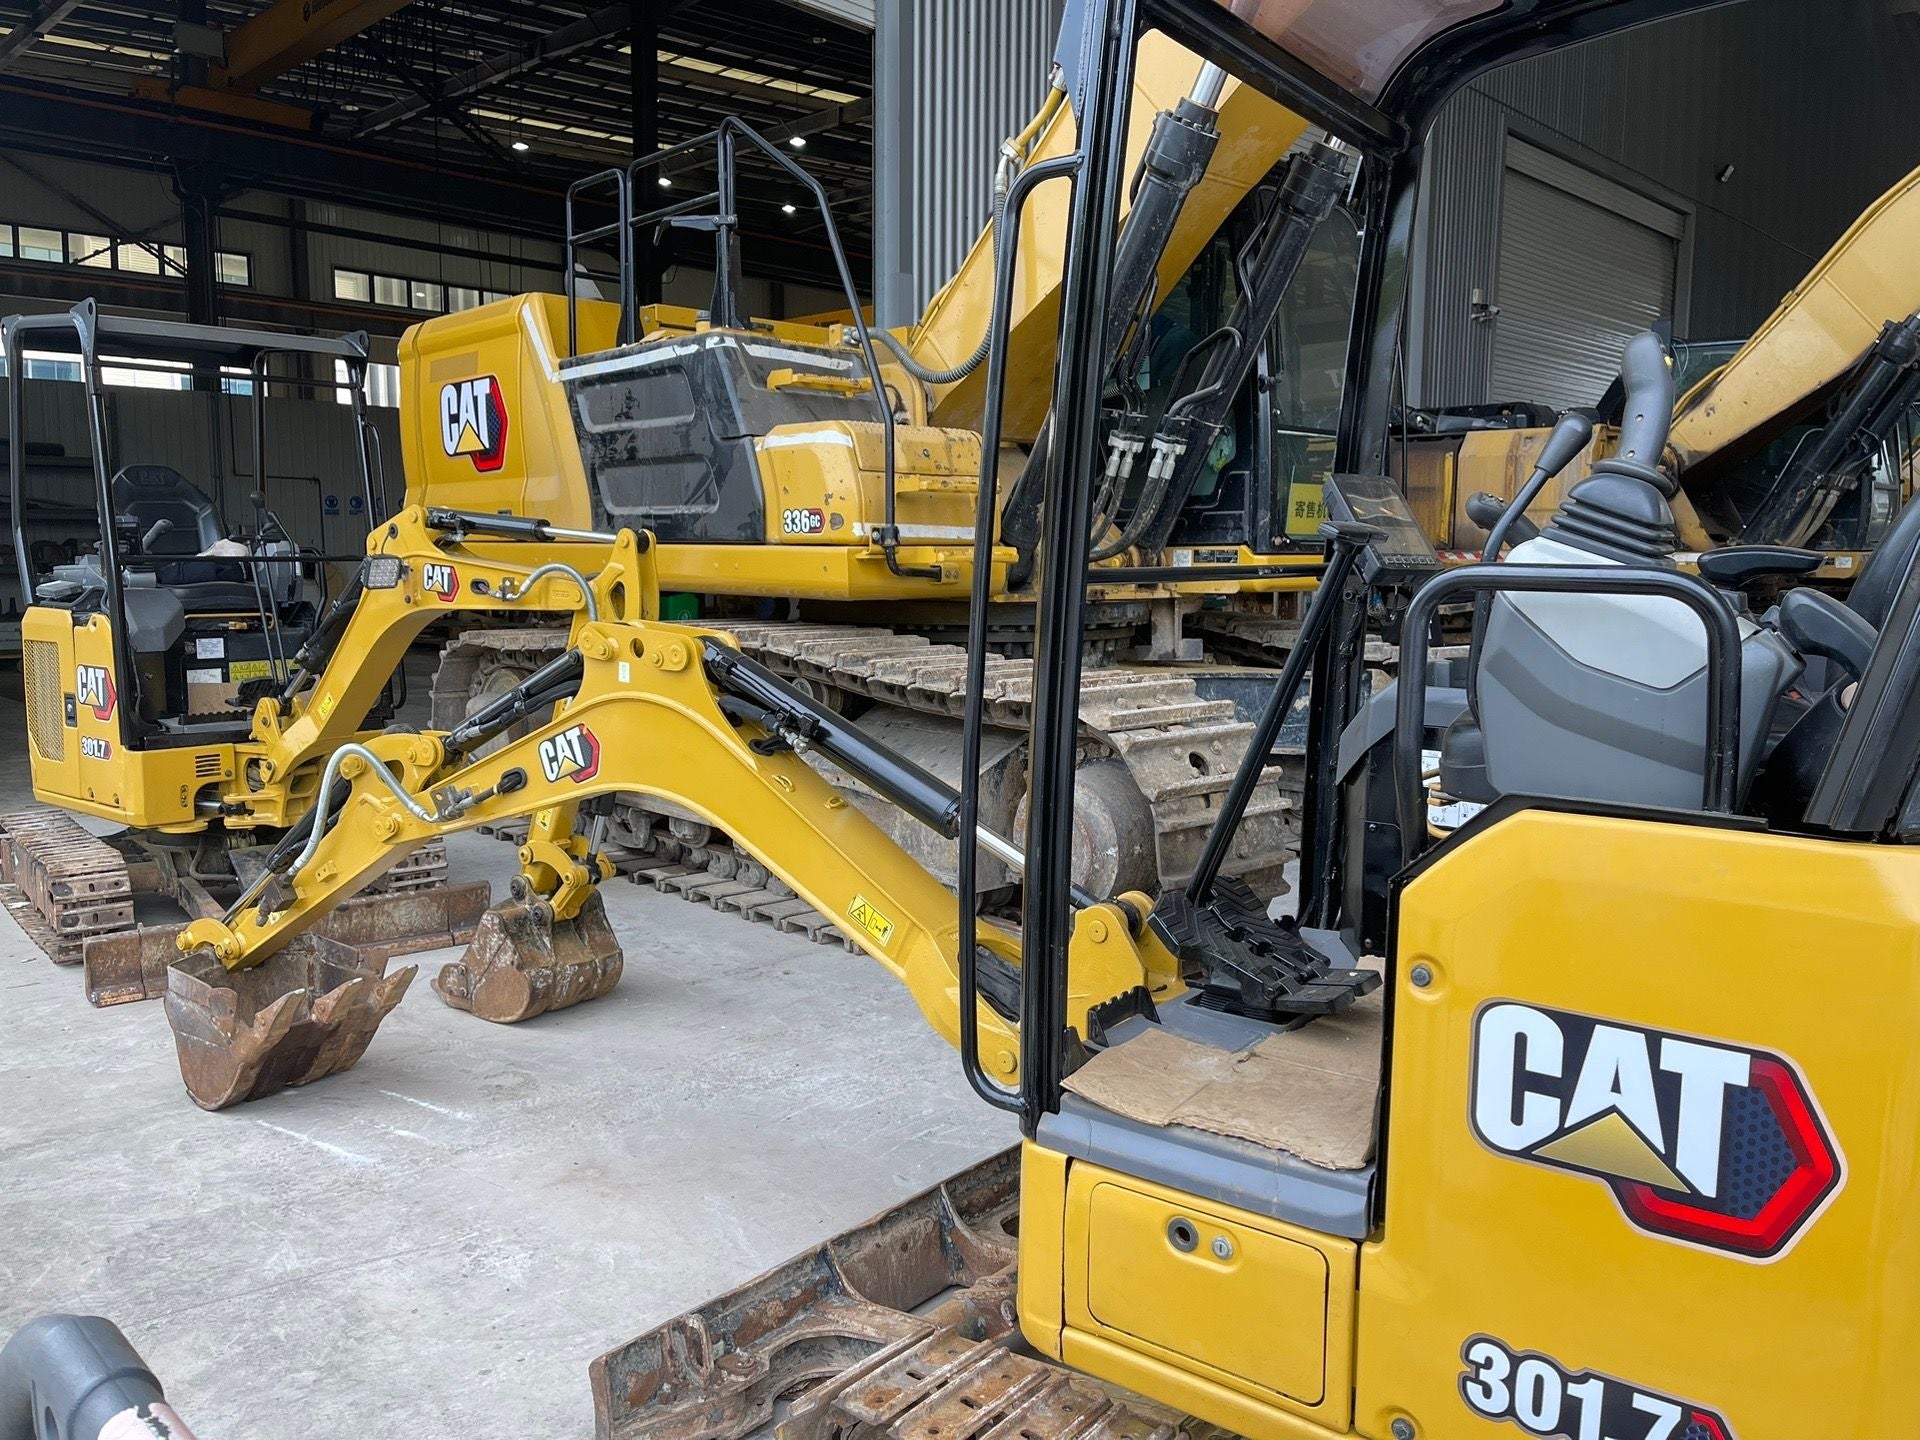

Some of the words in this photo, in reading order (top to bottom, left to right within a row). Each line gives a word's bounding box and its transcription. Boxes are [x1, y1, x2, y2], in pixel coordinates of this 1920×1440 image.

[441, 378, 490, 455] CAT
[424, 563, 450, 593] CAT
[78, 665, 105, 707] CAT
[82, 737, 105, 758] 301.7
[540, 726, 585, 781] CAT
[1476, 1004, 1751, 1198] CAT
[1466, 1342, 1683, 1440] 3017
